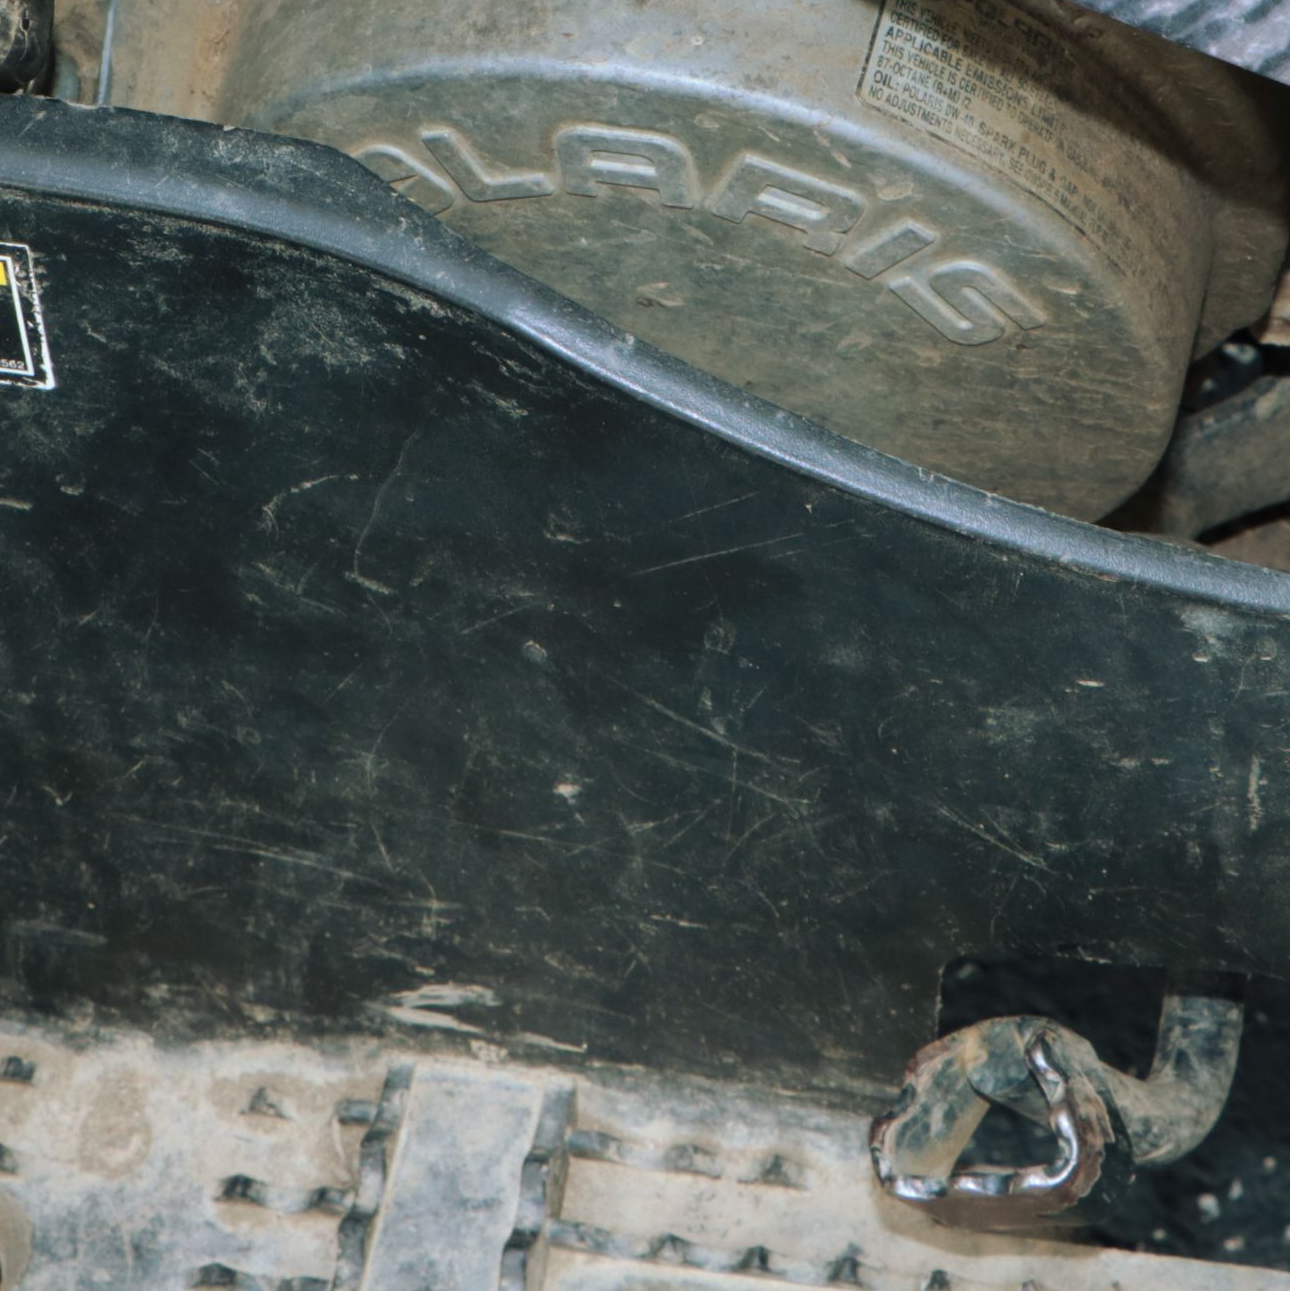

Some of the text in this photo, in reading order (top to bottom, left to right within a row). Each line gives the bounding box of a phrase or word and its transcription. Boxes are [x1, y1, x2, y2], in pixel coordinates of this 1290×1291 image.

[890, 12, 940, 41] CERTIFIED
[882, 38, 905, 60] THIS
[906, 51, 946, 79] VEHICLE
[947, 70, 958, 85] IS
[957, 76, 1005, 111] CERTIFIED
[884, 24, 963, 71] APPLICABLE
[964, 63, 1029, 110] EMISSIONS
[868, 84, 884, 101] NO
[884, 92, 952, 134] ADJUSTMENTS
[872, 69, 900, 91] OIL:
[902, 82, 944, 111] POLARIS
[979, 120, 1016, 153] SPARK
[1017, 145, 1047, 174] PLUG
